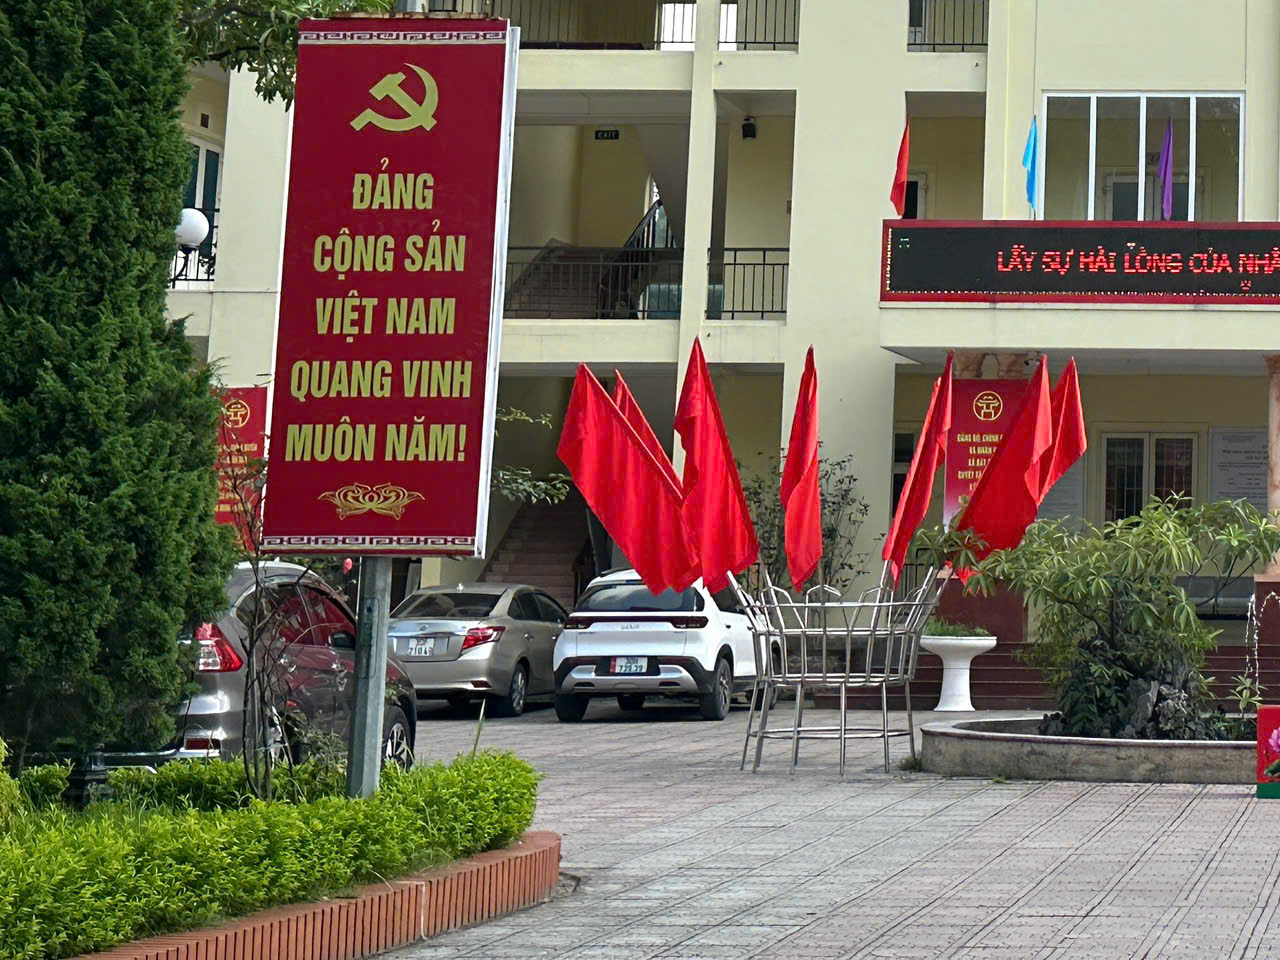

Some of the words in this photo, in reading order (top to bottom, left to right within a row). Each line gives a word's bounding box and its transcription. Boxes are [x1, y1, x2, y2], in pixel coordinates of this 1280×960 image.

[353, 158, 433, 209] ĐẢNG
[313, 228, 394, 280] CỘNG
[404, 220, 466, 272] SẢN
[998, 245, 1037, 272] LẤY
[1079, 246, 1117, 273] HÀI
[1124, 246, 1183, 273] LÒNG
[1189, 247, 1233, 274] CỦA
[316, 290, 378, 342] VIỆT
[385, 297, 456, 334] NAM
[291, 360, 392, 401] QUANG
[402, 360, 472, 398] VINH
[285, 416, 377, 462] MUÔN
[384, 416, 467, 462] NĂM!
